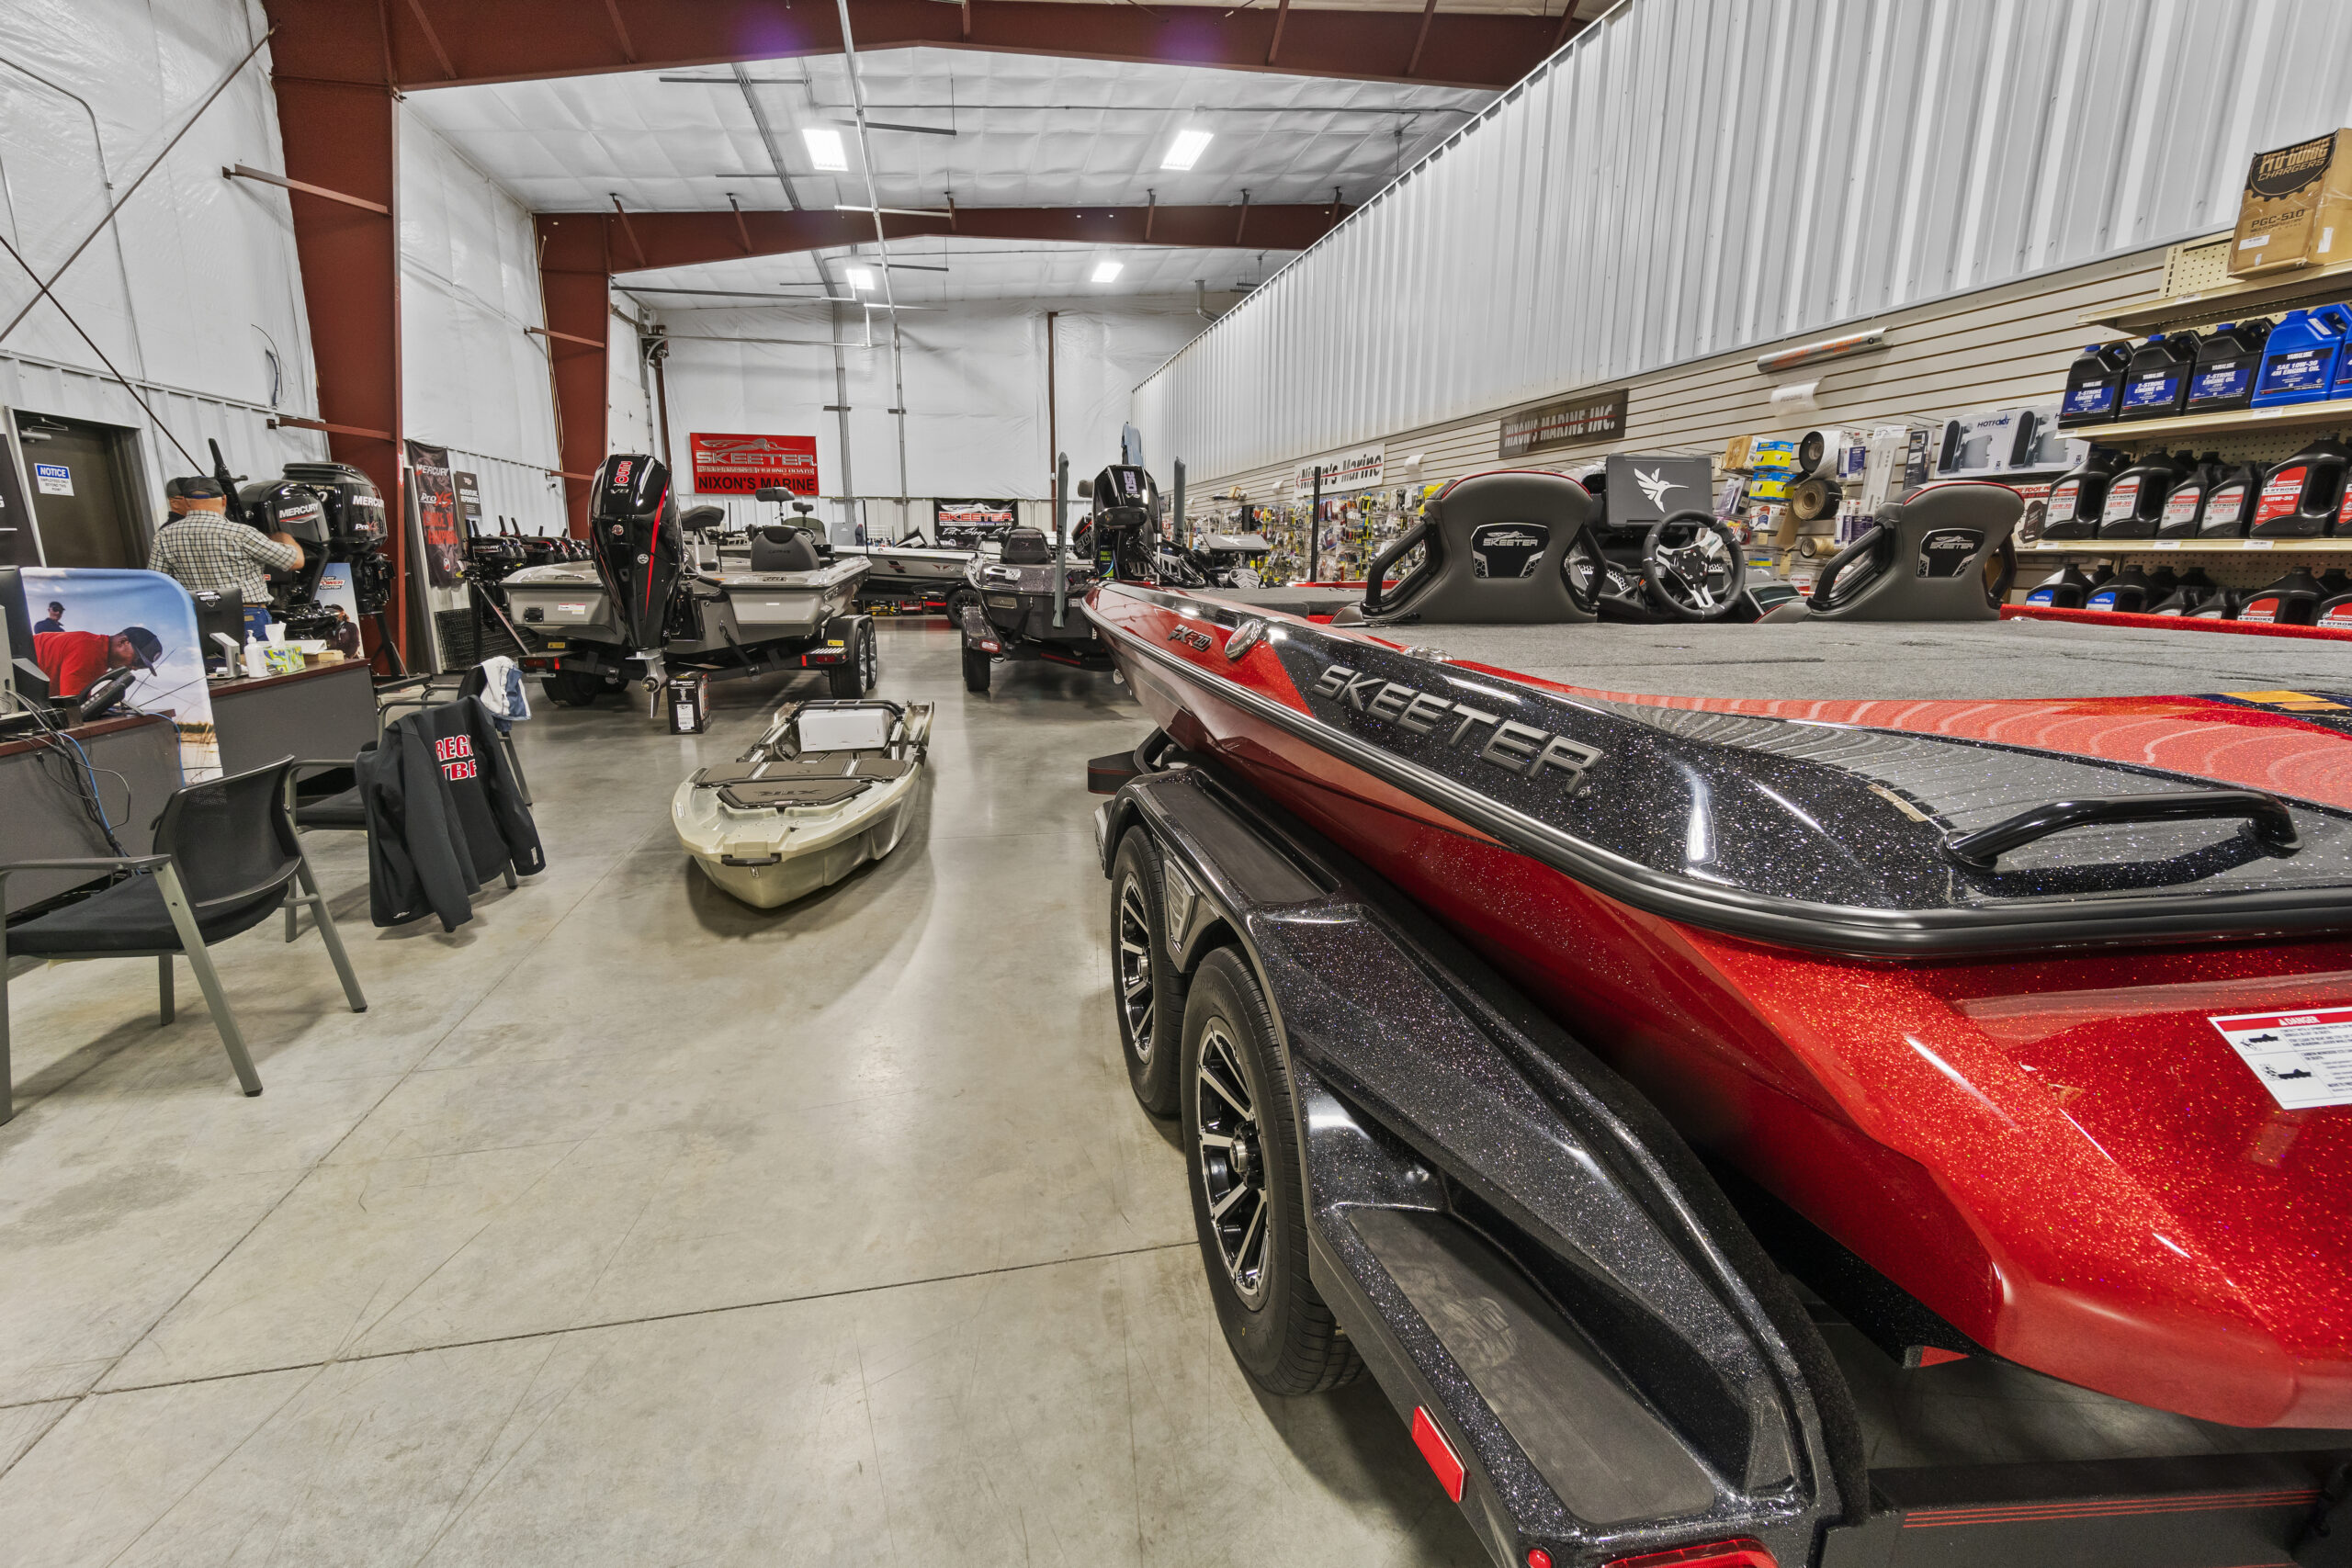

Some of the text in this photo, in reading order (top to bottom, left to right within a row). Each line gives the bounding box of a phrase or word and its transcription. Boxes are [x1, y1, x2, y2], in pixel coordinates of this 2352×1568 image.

[2257, 157, 2326, 182] CHARGERS
[2251, 209, 2305, 228] PGC-510
[2291, 360, 2318, 369] 10W-30
[2205, 371, 2235, 380] 2-STROKE
[2282, 367, 2308, 376] ENGINE
[2308, 365, 2320, 373] OIL
[2137, 380, 2165, 389] 2-STROKE
[2202, 378, 2224, 386] ENGINE
[2077, 389, 2102, 397] 2-STROKE
[2134, 386, 2155, 394] ENGINE
[1505, 404, 1615, 447] NIXON'S MARINE INC.
[1977, 418, 2011, 428] HOTFOOT
[695, 450, 814, 466] SKEETER
[40, 467, 67, 478] NOTICE
[415, 463, 450, 477] MERCURY
[1300, 453, 1383, 490] Nixn's Marine
[698, 477, 815, 491] NIXON'S MARINE
[1123, 470, 1138, 493] 250
[278, 502, 319, 518] MERCURY
[938, 512, 1012, 522] SKEETER
[1483, 537, 1539, 547] SKEETER
[1929, 541, 1974, 549] SKEETER
[1314, 664, 1604, 797] SKEETER
[2286, 1015, 2321, 1026] DANGER
